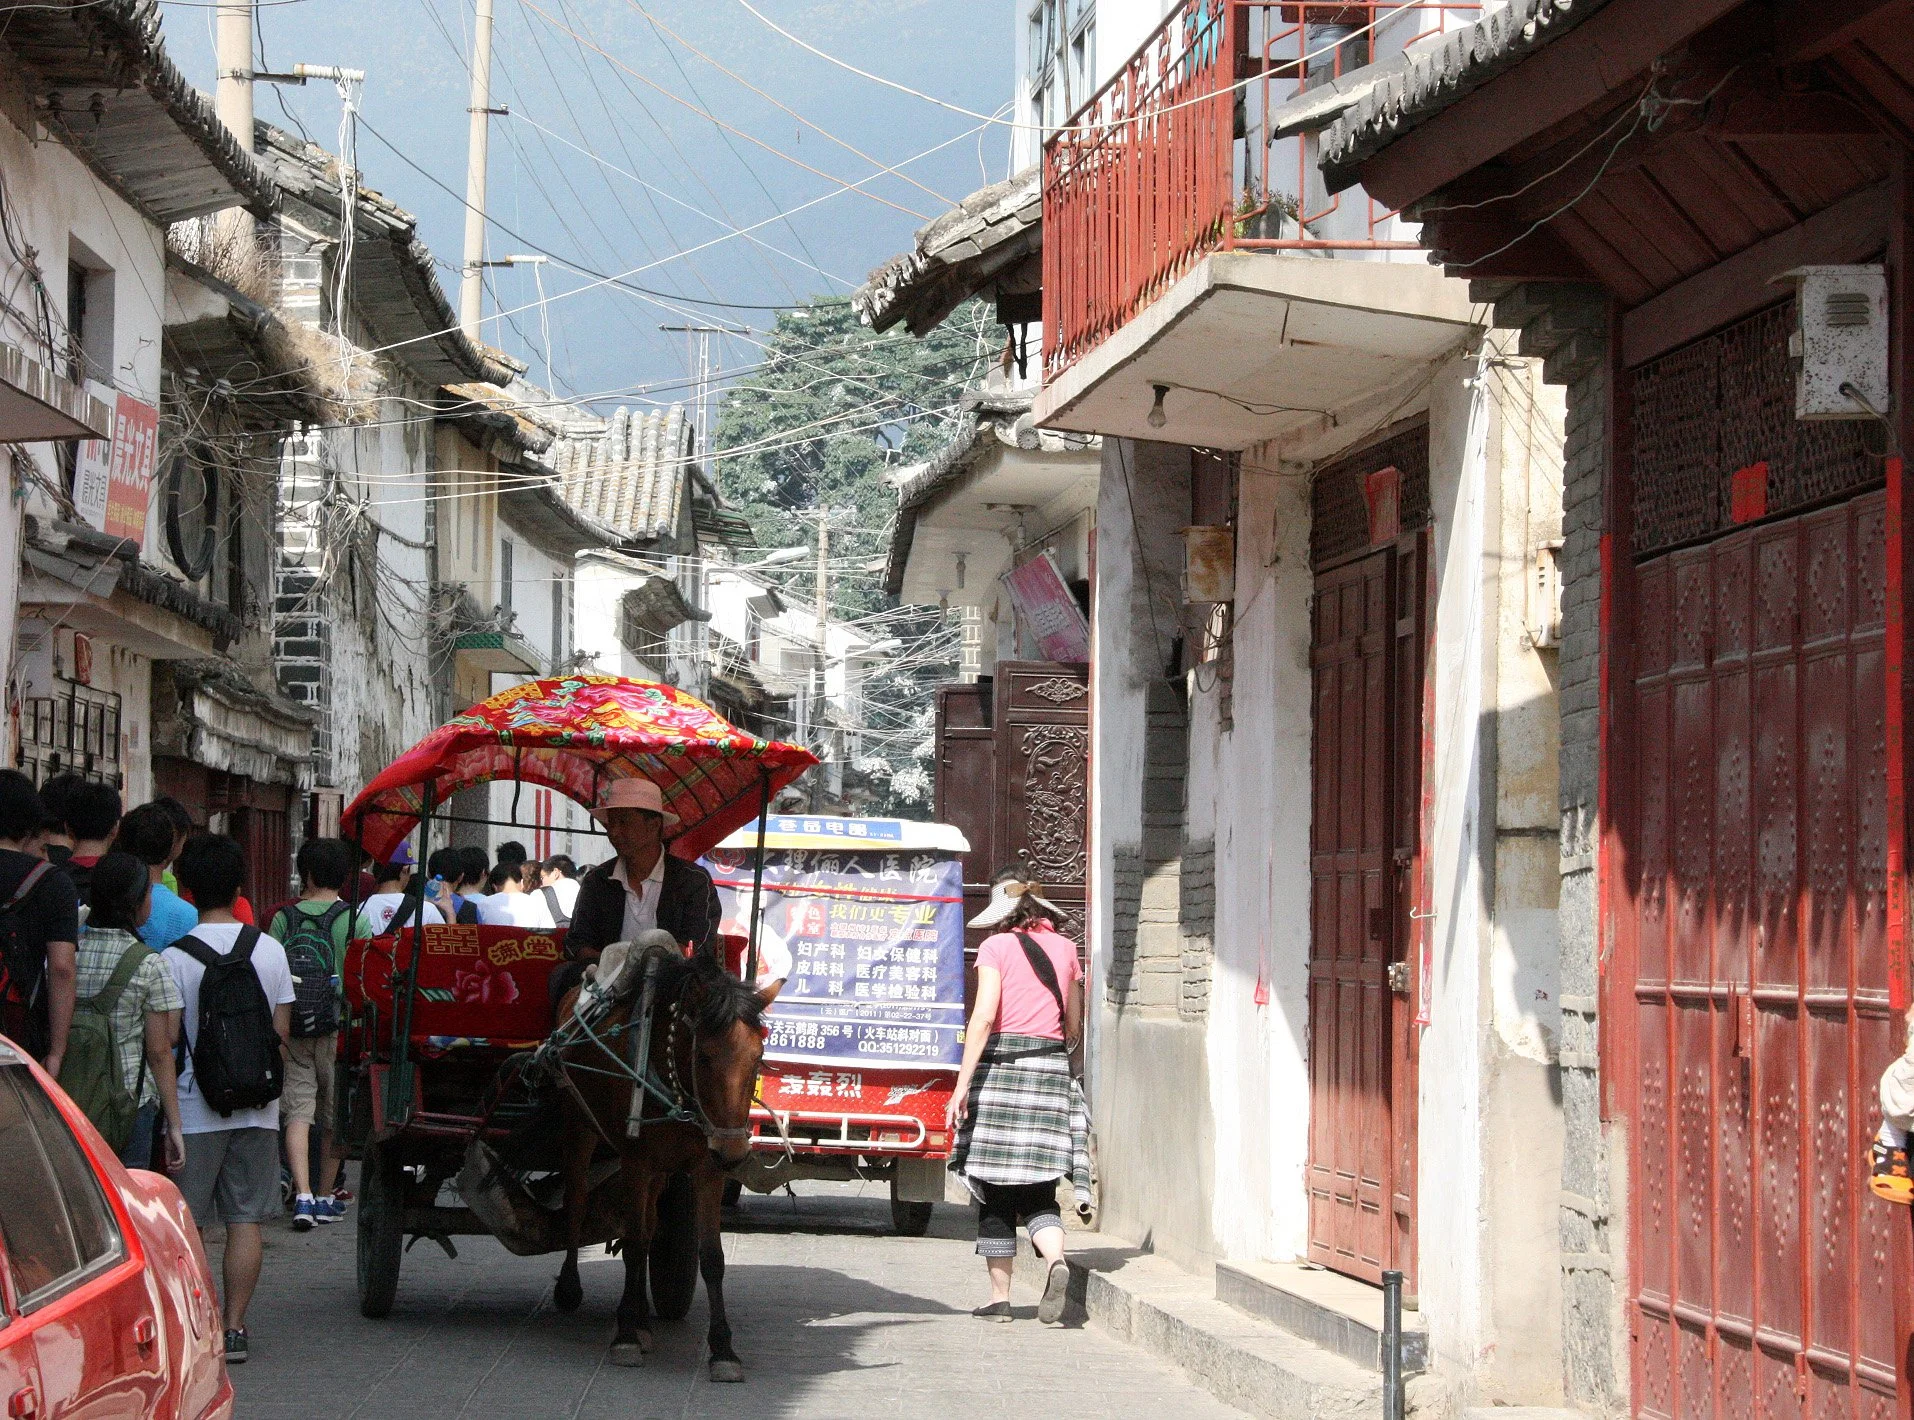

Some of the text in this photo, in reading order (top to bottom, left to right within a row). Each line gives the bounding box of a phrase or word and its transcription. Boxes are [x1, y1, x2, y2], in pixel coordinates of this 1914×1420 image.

[111, 414, 153, 493] 晨光文具
[829, 904, 937, 925] 我们更专业
[797, 942, 939, 964] 妇产科 妇女保健科
[795, 959, 938, 982] 皮肤科 医疗美容科
[854, 982, 937, 1001] 医学检验科
[858, 1041, 940, 1057] QQ:351292219
